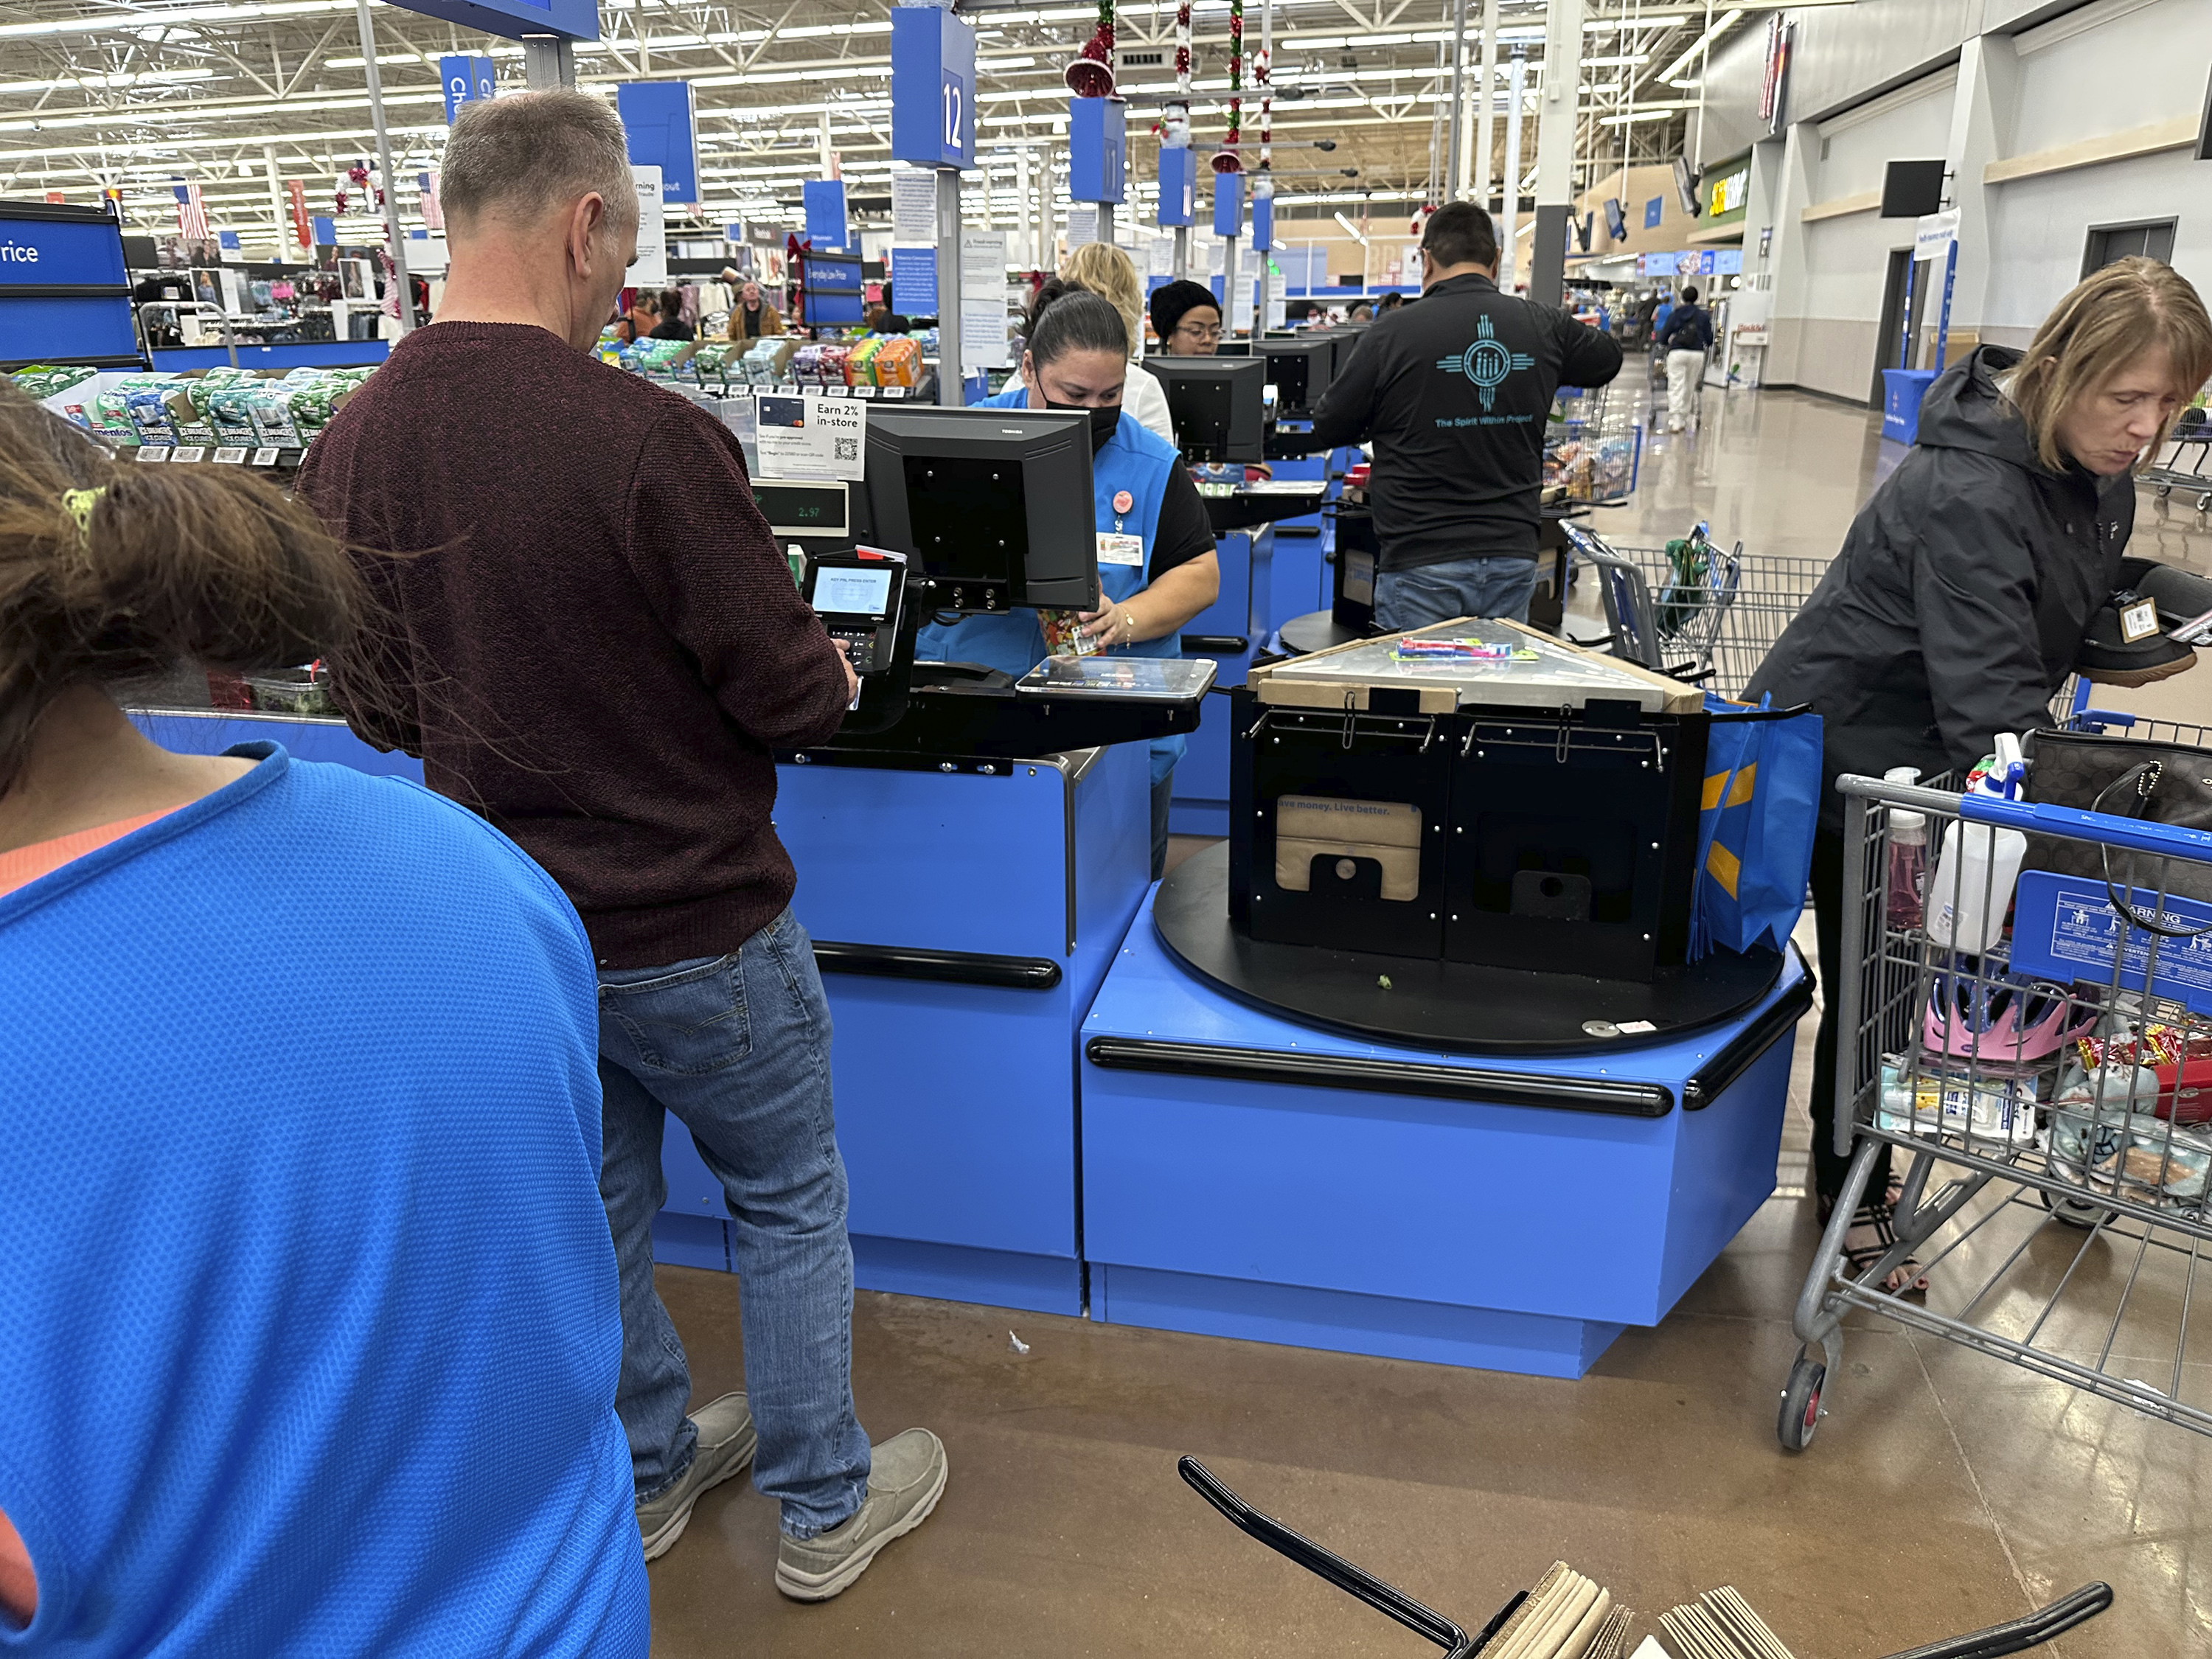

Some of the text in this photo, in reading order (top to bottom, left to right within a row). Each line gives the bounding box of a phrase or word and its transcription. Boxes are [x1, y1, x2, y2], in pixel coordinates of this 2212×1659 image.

[944, 83, 961, 148] 12
[0, 240, 38, 262] rice
[817, 403, 858, 417] Earn 2%
[817, 415, 858, 428] in-store
[1435, 414, 1532, 428] The Spirit Within Project
[94, 428, 133, 437] mentos
[799, 507, 820, 517] 2.97
[1297, 801, 1332, 813] money.
[1335, 803, 1356, 812] Live
[1357, 804, 1390, 815] better.
